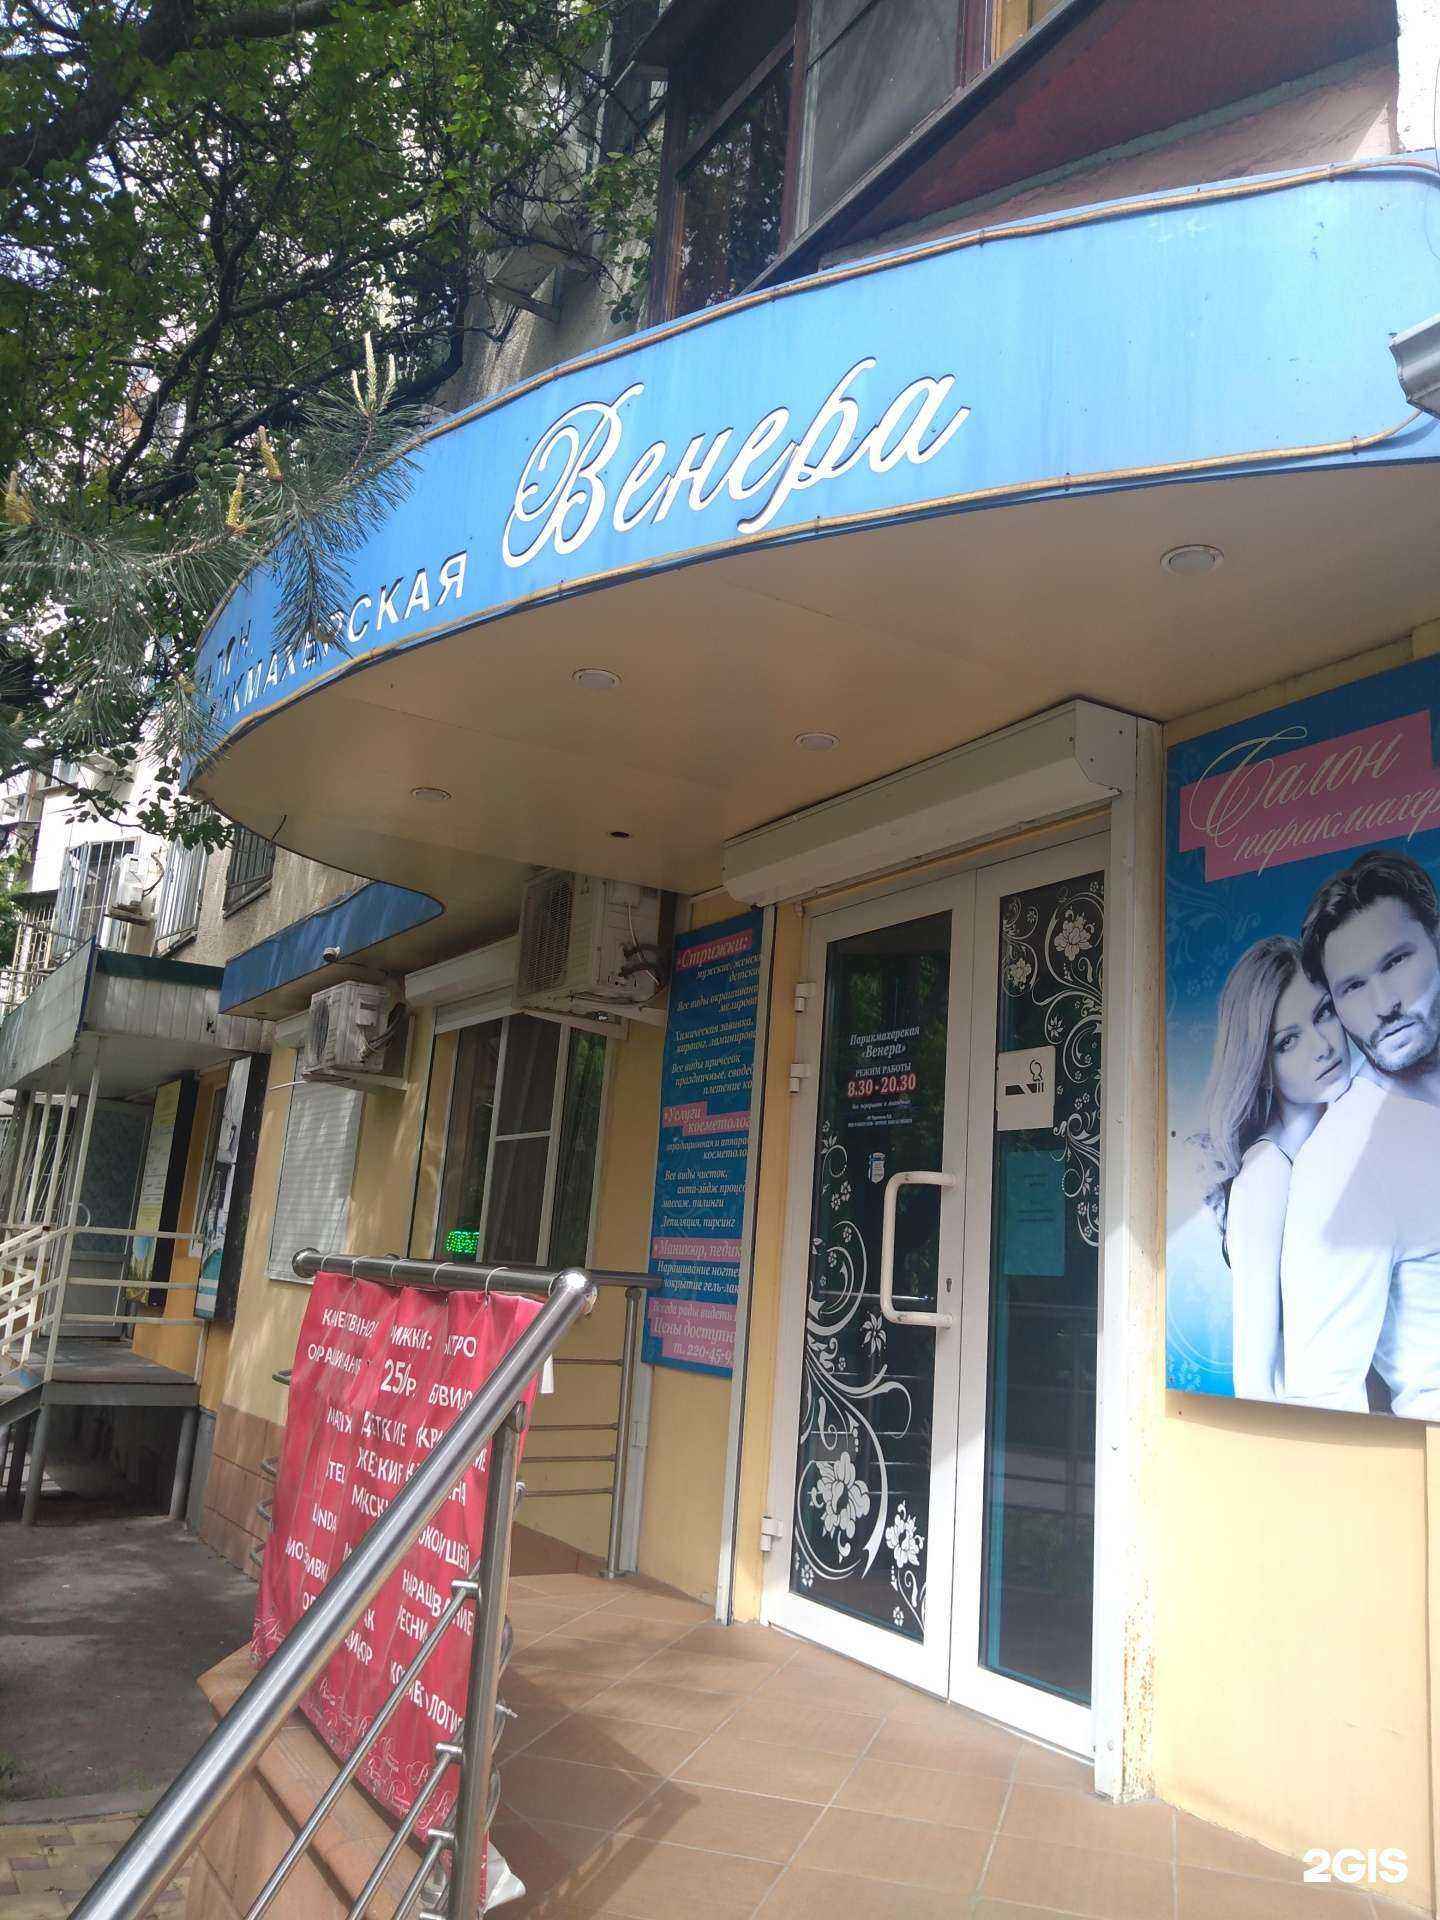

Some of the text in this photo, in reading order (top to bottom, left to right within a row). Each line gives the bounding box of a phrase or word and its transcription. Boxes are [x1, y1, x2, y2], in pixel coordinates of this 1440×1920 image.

[502, 356, 972, 568] Венера
[1189, 726, 1403, 848] Салон
[849, 1026, 920, 1047] Парикмахерская
[856, 1062, 912, 1078] РЕЖИМ РАБОТЫ
[654, 1317, 681, 1337] Цены
